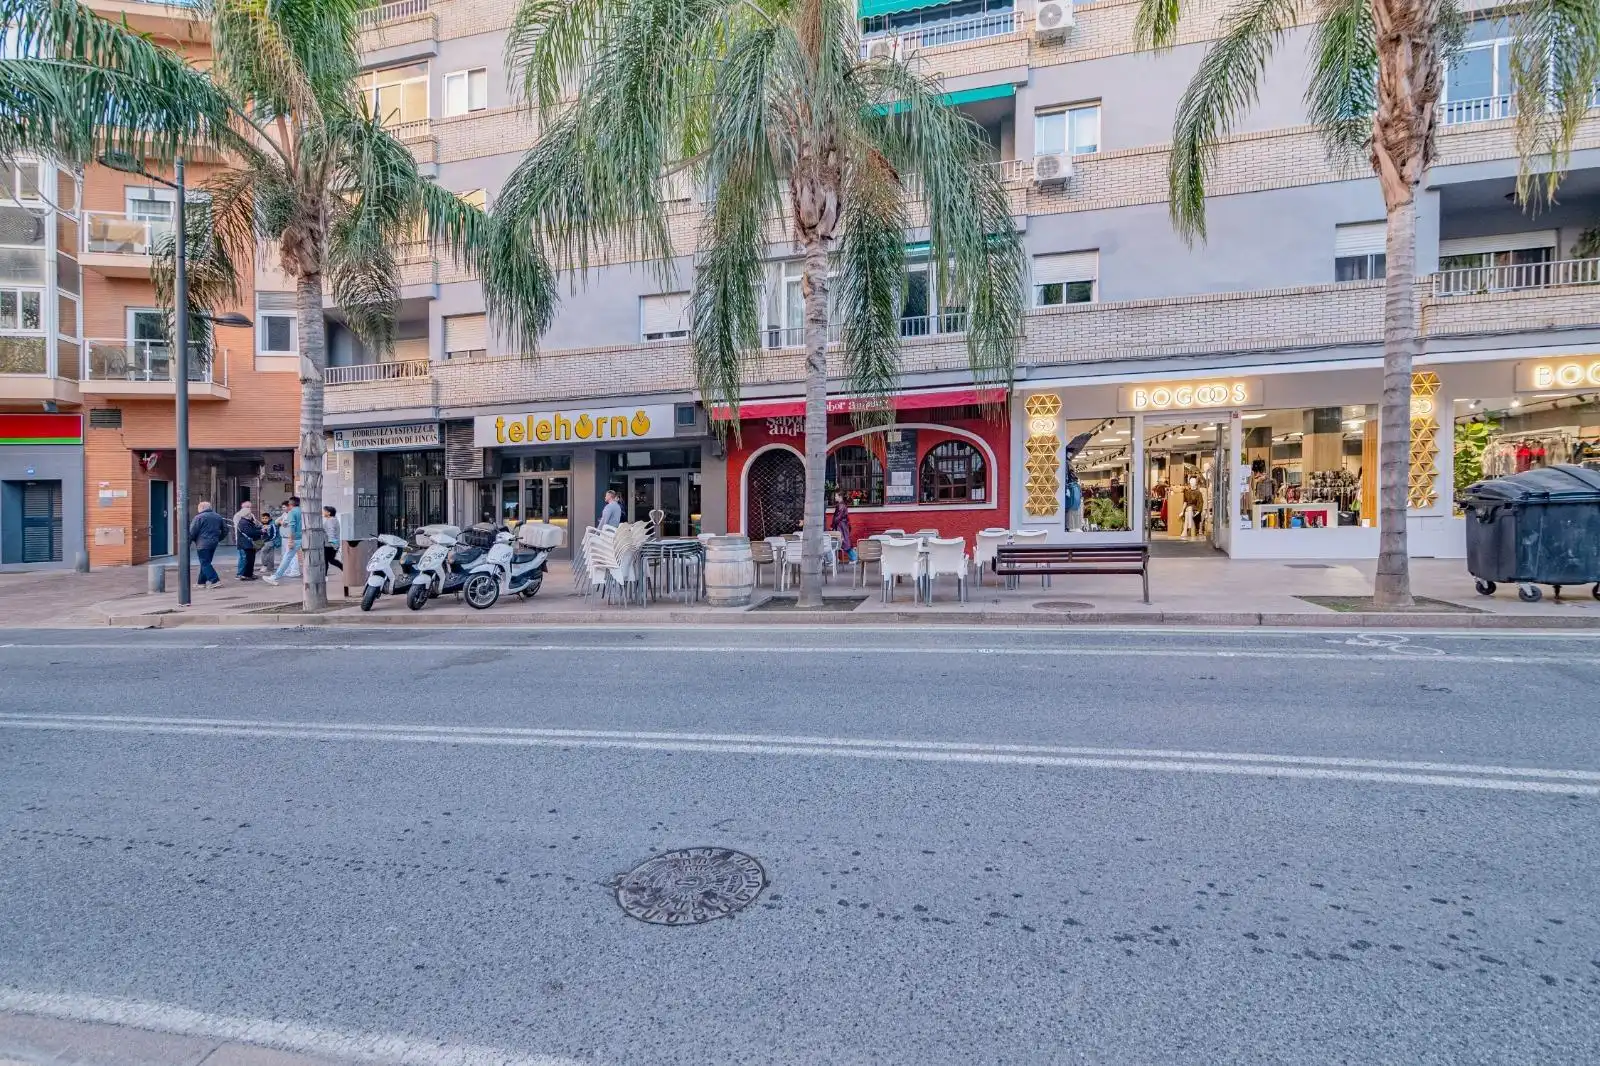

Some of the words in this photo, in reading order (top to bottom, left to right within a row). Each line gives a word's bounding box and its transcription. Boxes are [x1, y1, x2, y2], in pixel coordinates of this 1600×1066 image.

[494, 408, 651, 443] telehorno
[404, 436, 413, 445] DE
[414, 433, 438, 443] FINCAS
